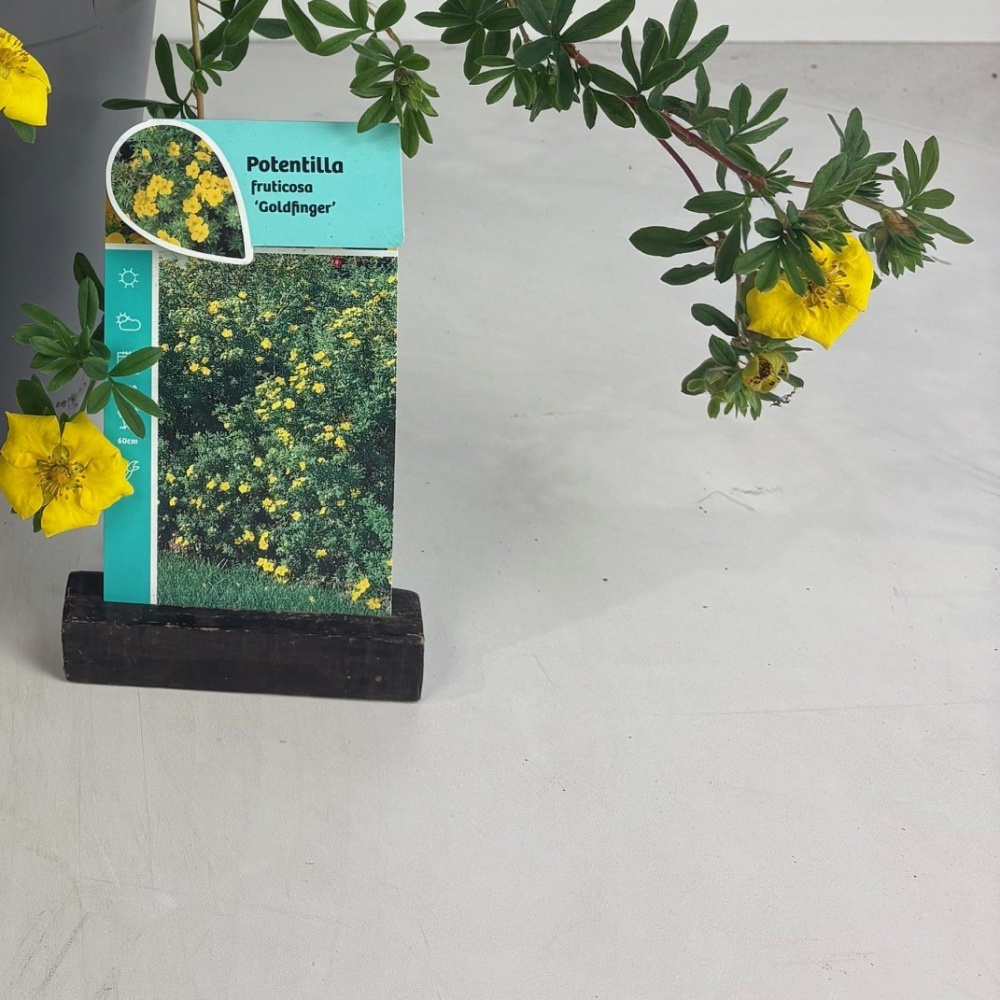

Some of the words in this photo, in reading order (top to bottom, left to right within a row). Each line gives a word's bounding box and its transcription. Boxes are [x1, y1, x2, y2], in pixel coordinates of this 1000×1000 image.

[247, 156, 343, 173] Potentilla
[251, 180, 313, 195] fruticosa
[117, 437, 138, 445] 60cm
